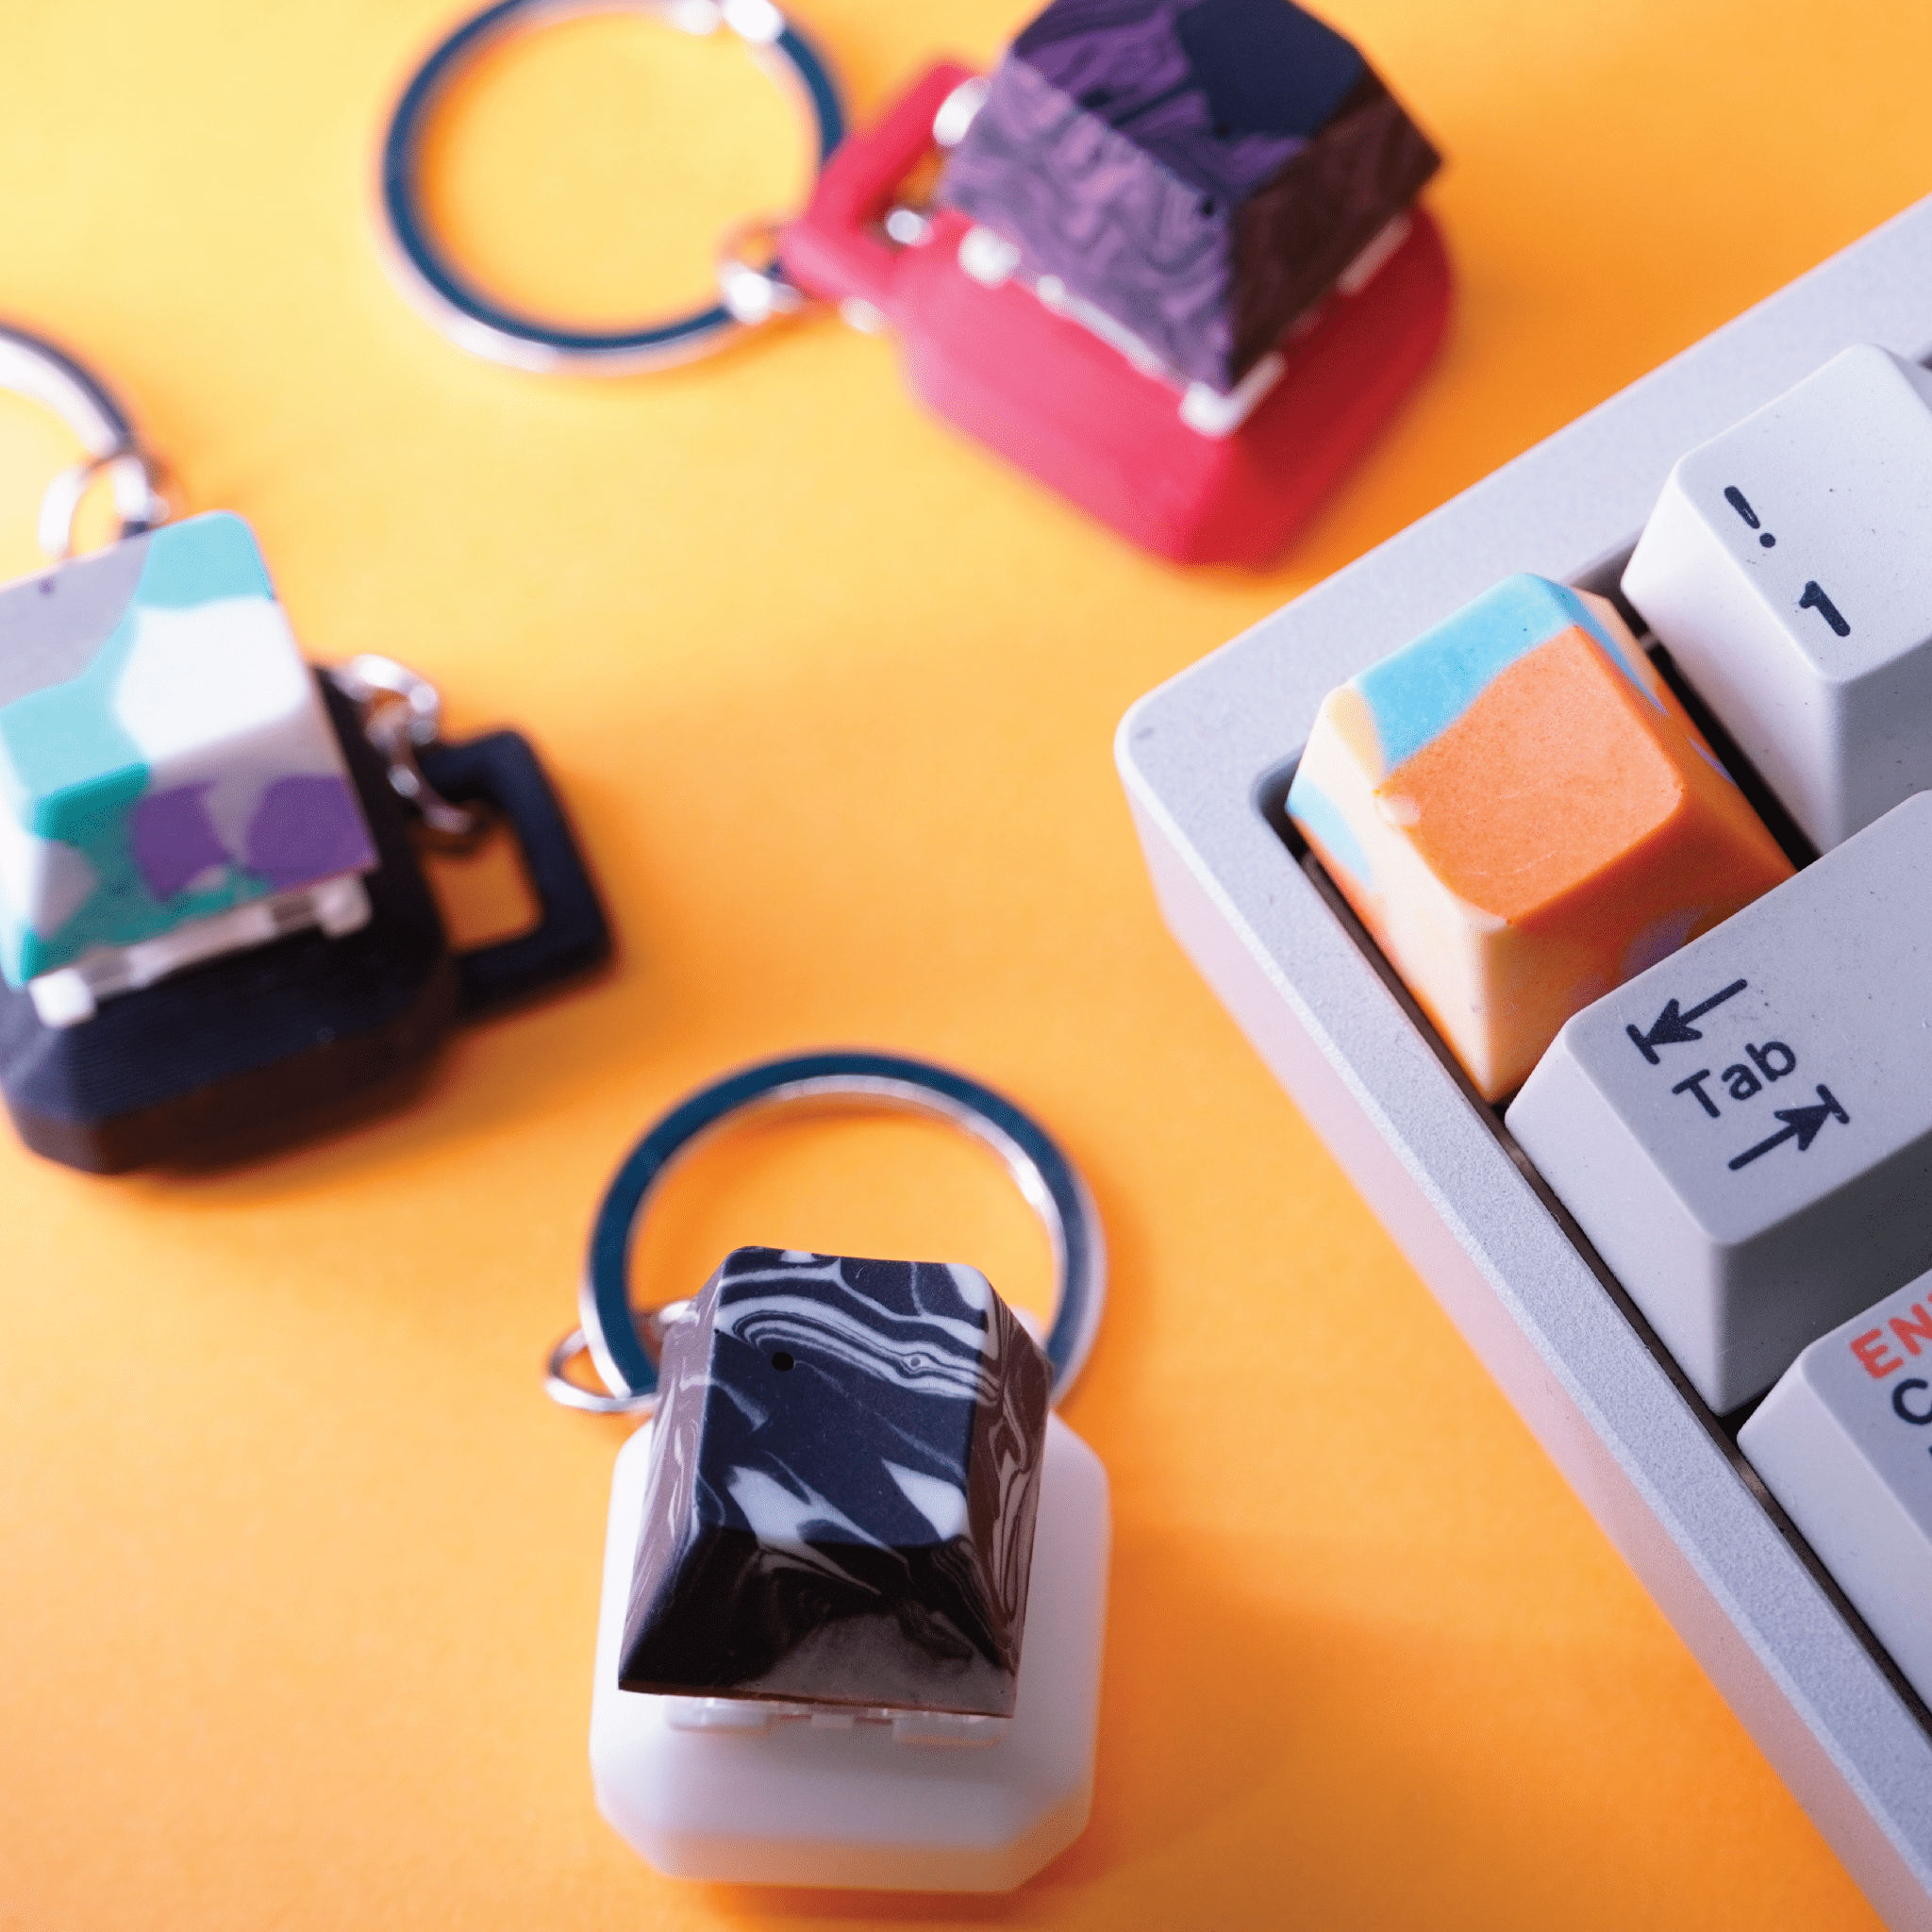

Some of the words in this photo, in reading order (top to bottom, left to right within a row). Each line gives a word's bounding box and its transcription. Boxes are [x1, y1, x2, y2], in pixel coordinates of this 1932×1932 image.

[1724, 486, 1776, 548] !
[1799, 580, 1851, 637] 1
[1672, 1041, 1796, 1118] Tab
[1849, 1292, 1932, 1379] EN
